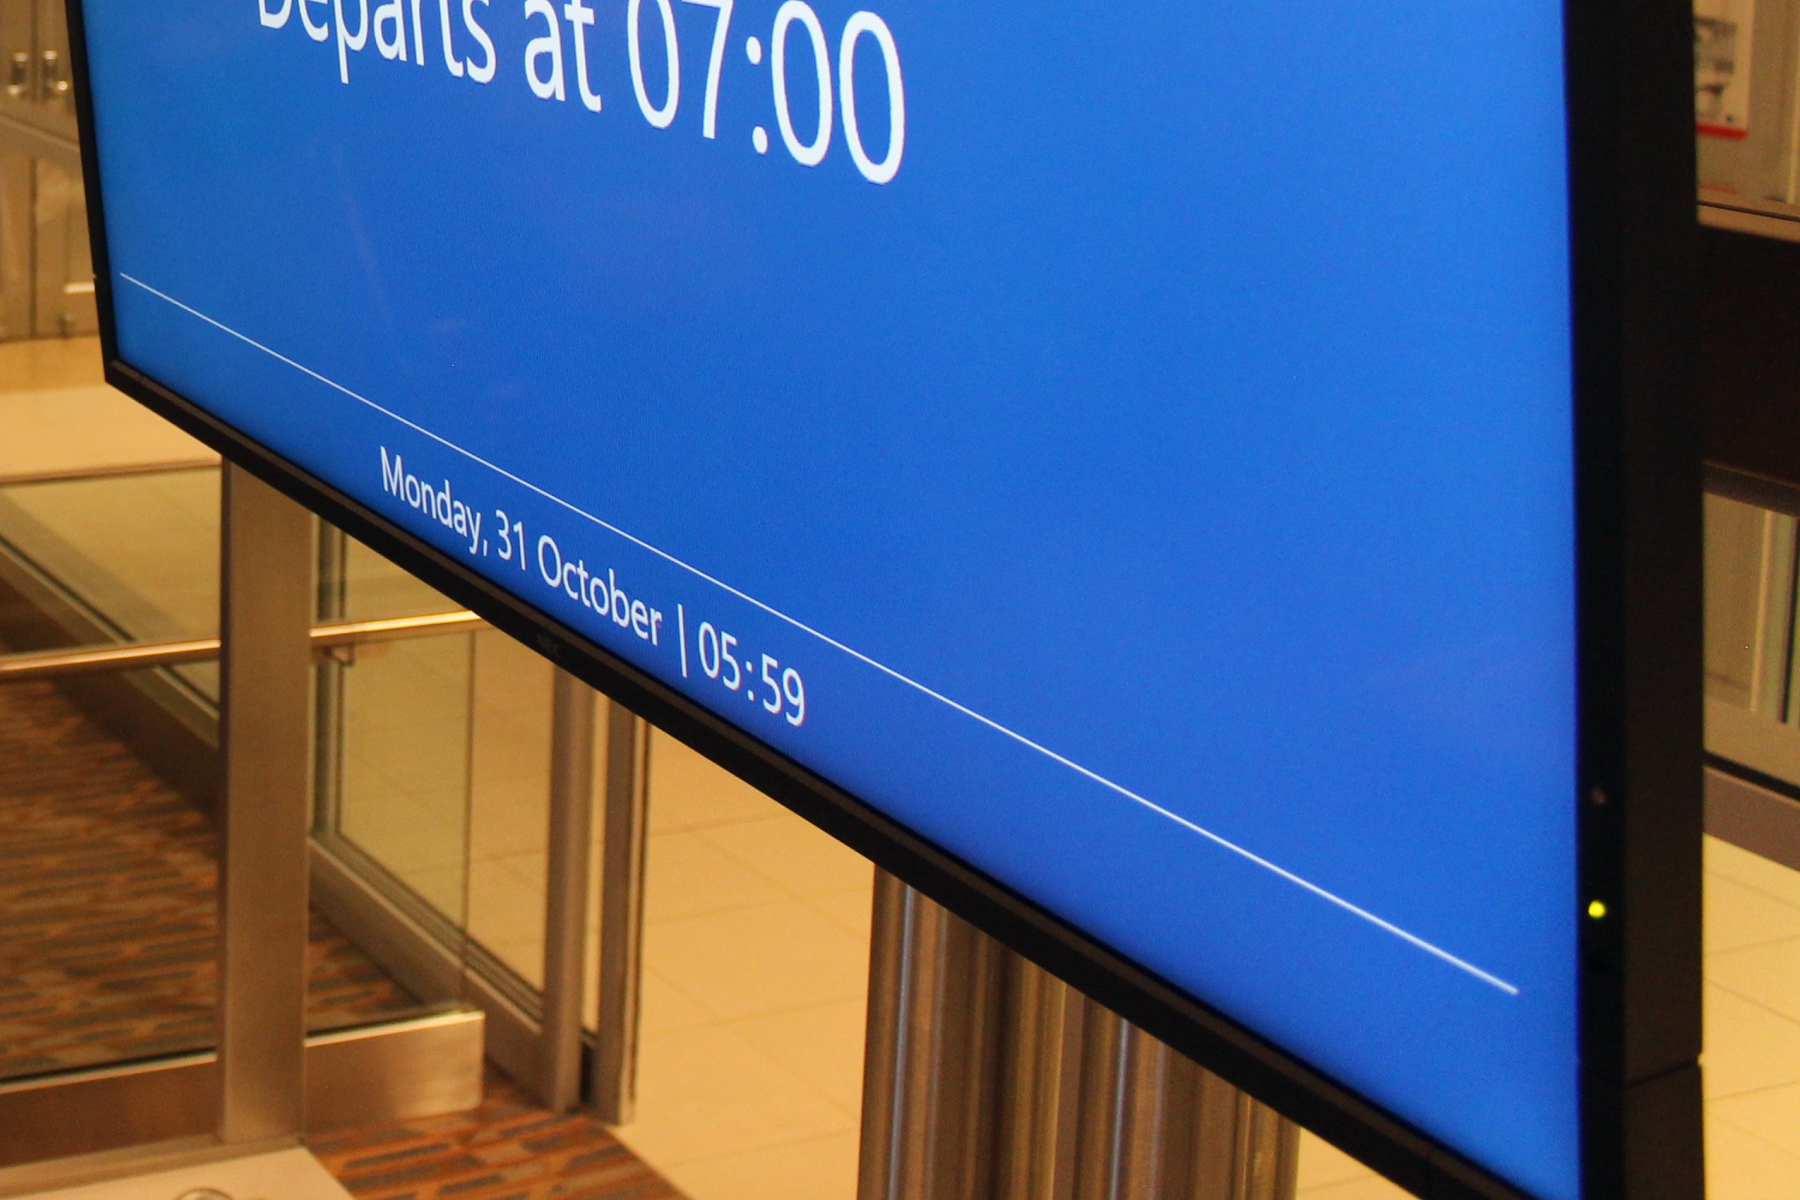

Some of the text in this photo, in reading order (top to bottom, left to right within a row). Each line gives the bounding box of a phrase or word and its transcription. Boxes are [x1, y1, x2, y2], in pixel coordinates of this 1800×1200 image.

[380, 445, 488, 558] Monday,
[495, 509, 526, 571] 31
[537, 535, 663, 647] October
[698, 621, 806, 728] 05:59
